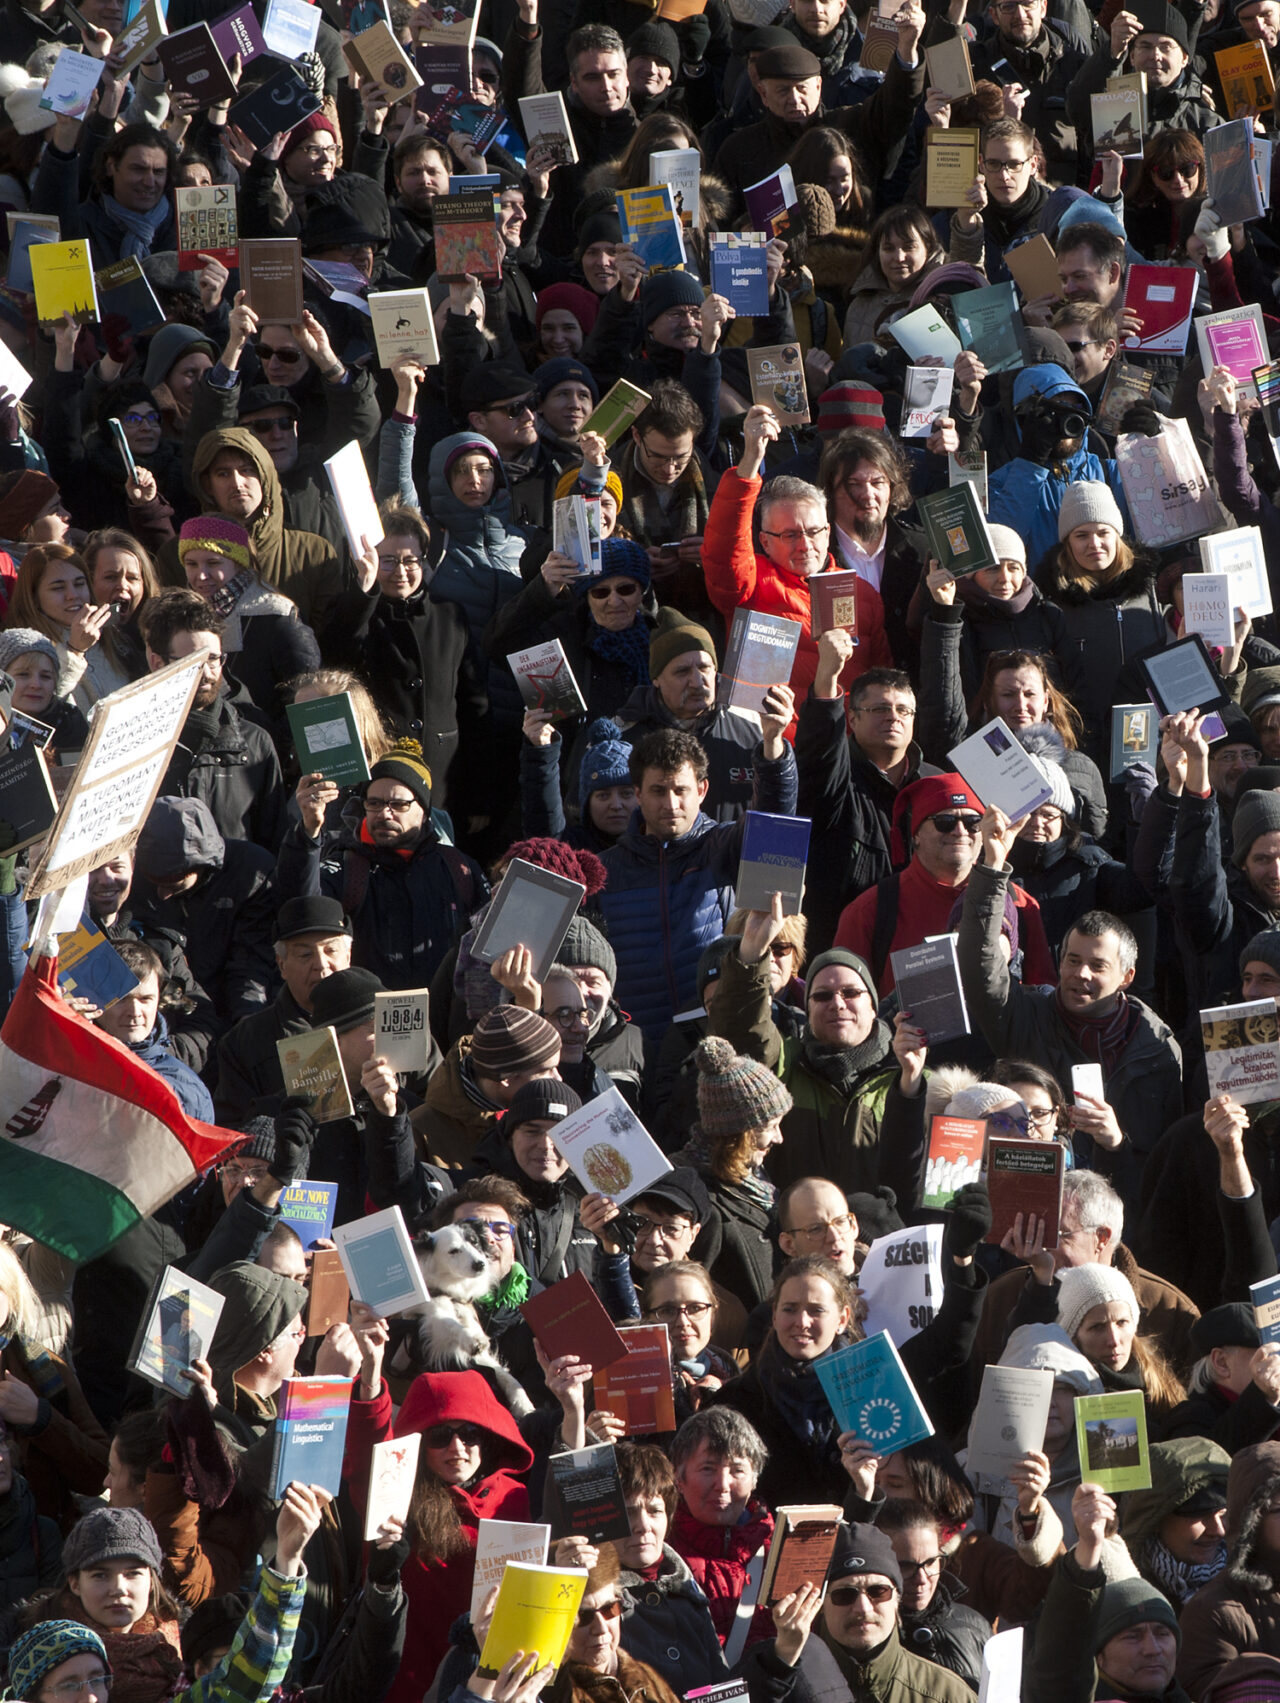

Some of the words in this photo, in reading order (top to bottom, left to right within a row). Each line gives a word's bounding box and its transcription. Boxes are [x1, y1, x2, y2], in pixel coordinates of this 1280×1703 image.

[235, 17, 254, 54] MAGYAR
[1221, 67, 1240, 76] CLAY
[1243, 61, 1263, 71] GODS
[463, 200, 492, 208] THEORY
[716, 250, 740, 261] Pólya
[1191, 583, 1221, 594] Harari
[1188, 601, 1226, 611] HOMO
[1192, 611, 1224, 622] DEUS
[750, 622, 778, 635] KOGNITÍV
[747, 632, 794, 650] IDEGTUDOMÁNY
[516, 654, 559, 675] UNGARNAUFSTAND
[518, 654, 529, 664] DER
[100, 735, 126, 752] NEM
[170, 702, 184, 714] AZ
[387, 996, 415, 1004] ORWELL
[381, 1008, 423, 1032] 1984
[1230, 1052, 1277, 1065] Legitimitás,
[298, 1064, 319, 1077] John
[1243, 1060, 1278, 1073] bizalom,
[291, 1069, 340, 1092] Banville
[1216, 1072, 1278, 1090] együttműködés
[561, 1123, 587, 1141] Discovering
[996, 1159, 1018, 1167] fertőző
[1011, 1154, 1046, 1162] háziállatok
[285, 1189, 306, 1201] ALEC
[307, 1191, 330, 1204] NOVE
[281, 1203, 328, 1221] SZOCIALIZMUS
[293, 1422, 334, 1432] Mathematical
[292, 1433, 323, 1445] Linguistics
[724, 1686, 746, 1697] IVÁN
